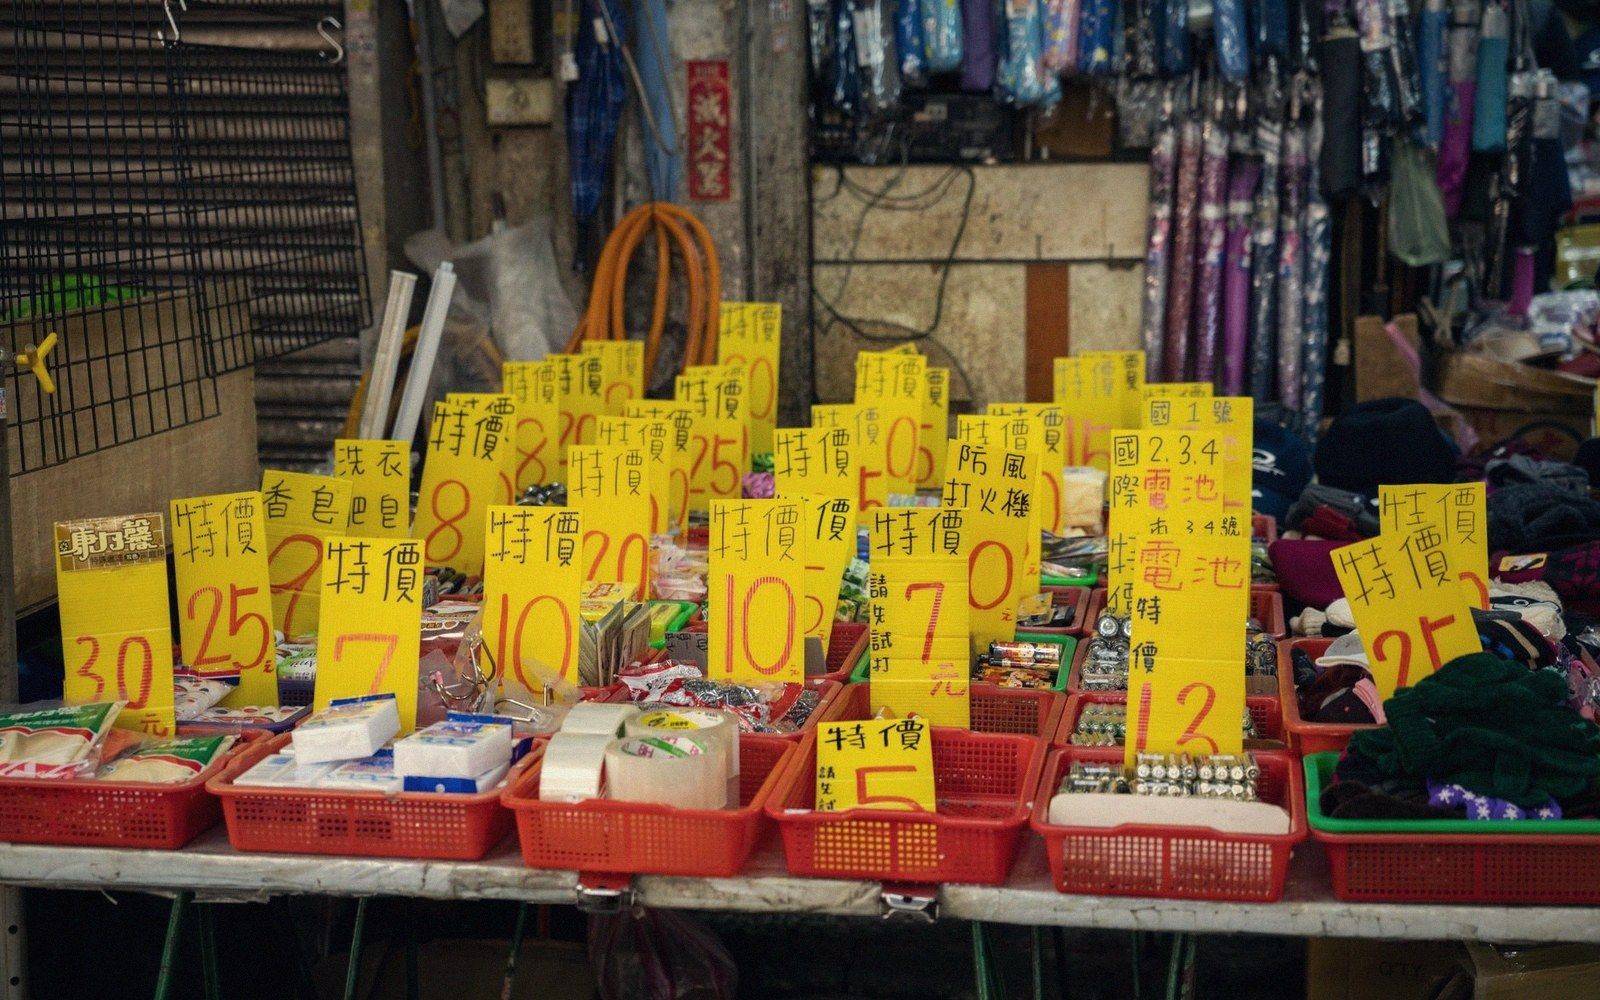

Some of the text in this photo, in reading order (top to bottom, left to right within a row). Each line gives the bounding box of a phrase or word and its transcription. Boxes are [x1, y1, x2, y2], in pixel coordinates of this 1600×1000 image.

[504, 364, 556, 403] 特價
[680, 378, 742, 420] 特價
[859, 356, 921, 399] 特價
[338, 446, 403, 477] 洗衣
[430, 406, 503, 461] 特價
[777, 428, 850, 478] 特價
[571, 449, 643, 498] 特價
[689, 434, 739, 496] 25
[958, 445, 1027, 480] 防風
[1144, 469, 1218, 510] 電池
[263, 480, 339, 524] 香皂
[424, 479, 471, 563] 8
[944, 479, 1030, 518] 打火機
[175, 497, 257, 563] 特價
[490, 510, 579, 567] 特價
[713, 503, 799, 562] 特價
[876, 509, 963, 557] 特價
[327, 541, 419, 603] 特價
[1139, 540, 1244, 591] 電池
[1338, 525, 1452, 606] 特價
[187, 583, 270, 670] 25
[497, 593, 573, 695] 10
[725, 573, 796, 676] 10
[869, 573, 893, 673] 請先試打
[905, 582, 966, 696] 7 元
[1132, 596, 1161, 673] 特價
[76, 636, 153, 710] 30
[334, 633, 398, 695] 7
[825, 720, 924, 751] 特價
[1136, 682, 1219, 754] 12
[855, 765, 926, 811] 5
